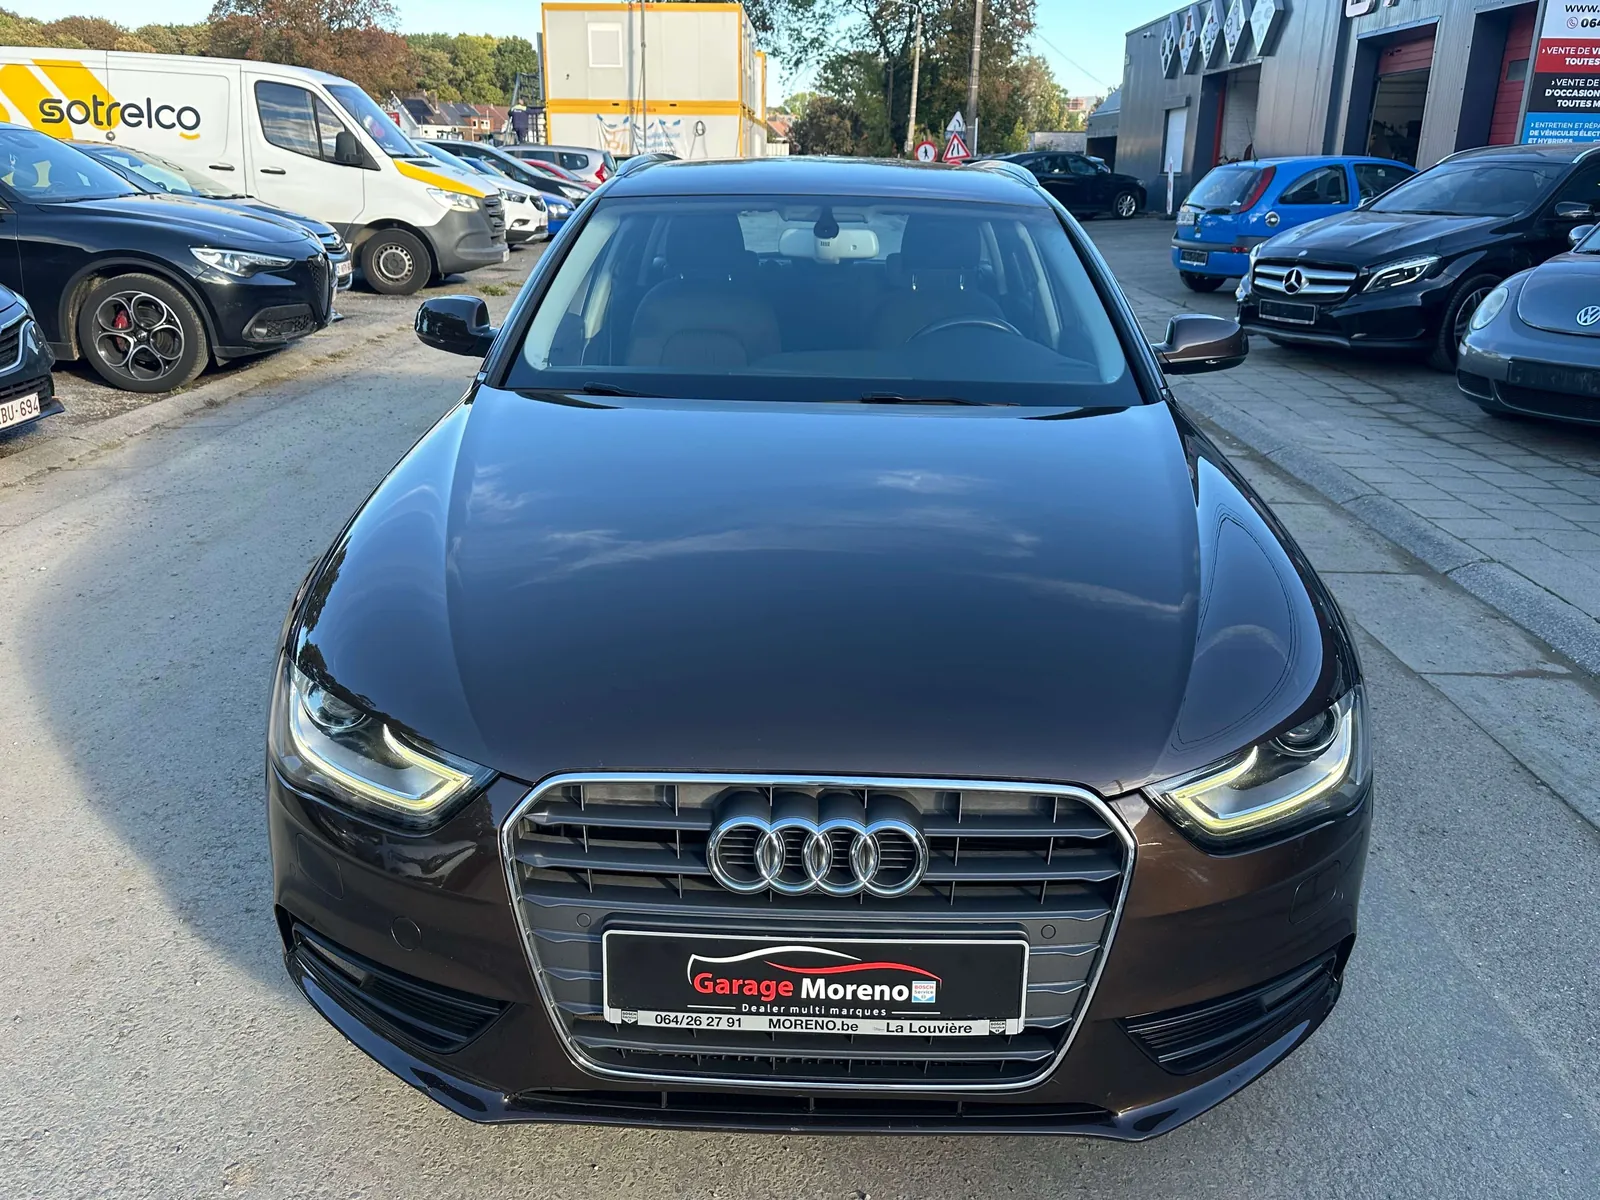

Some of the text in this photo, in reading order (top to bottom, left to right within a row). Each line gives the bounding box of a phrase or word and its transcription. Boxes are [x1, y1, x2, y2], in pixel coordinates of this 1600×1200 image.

[1565, 57, 1600, 65] TOUTES
[39, 94, 201, 131] sotrelco
[1557, 99, 1592, 107] TOUTES
[0, 397, 38, 424] BU-694
[693, 972, 909, 1001] Garage Moreno
[742, 1003, 887, 1017] Dealer multi marques
[655, 1013, 973, 1034] 064/26 27 91 MORENO.be La Louvière
